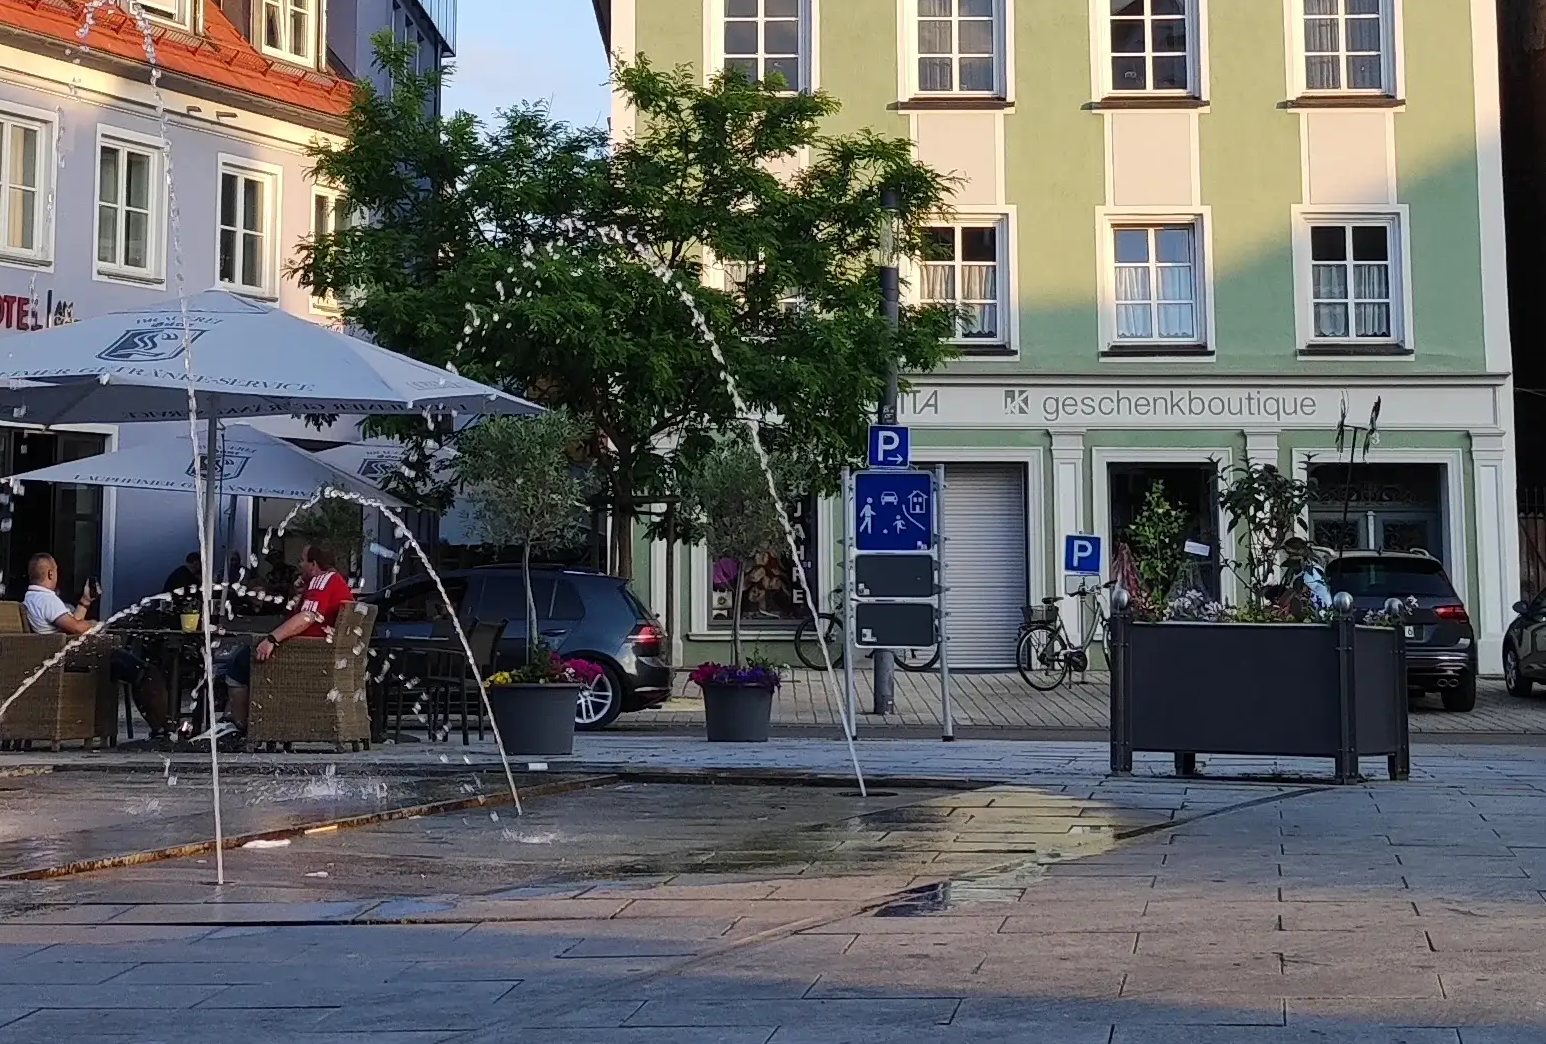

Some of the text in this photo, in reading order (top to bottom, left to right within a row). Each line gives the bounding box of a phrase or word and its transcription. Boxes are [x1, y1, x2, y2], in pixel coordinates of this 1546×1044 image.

[54, 299, 74, 317] AM
[900, 389, 939, 415] ITA
[1042, 389, 1317, 422] geschenkboutique
[877, 430, 900, 462] P
[1072, 539, 1093, 568] P
